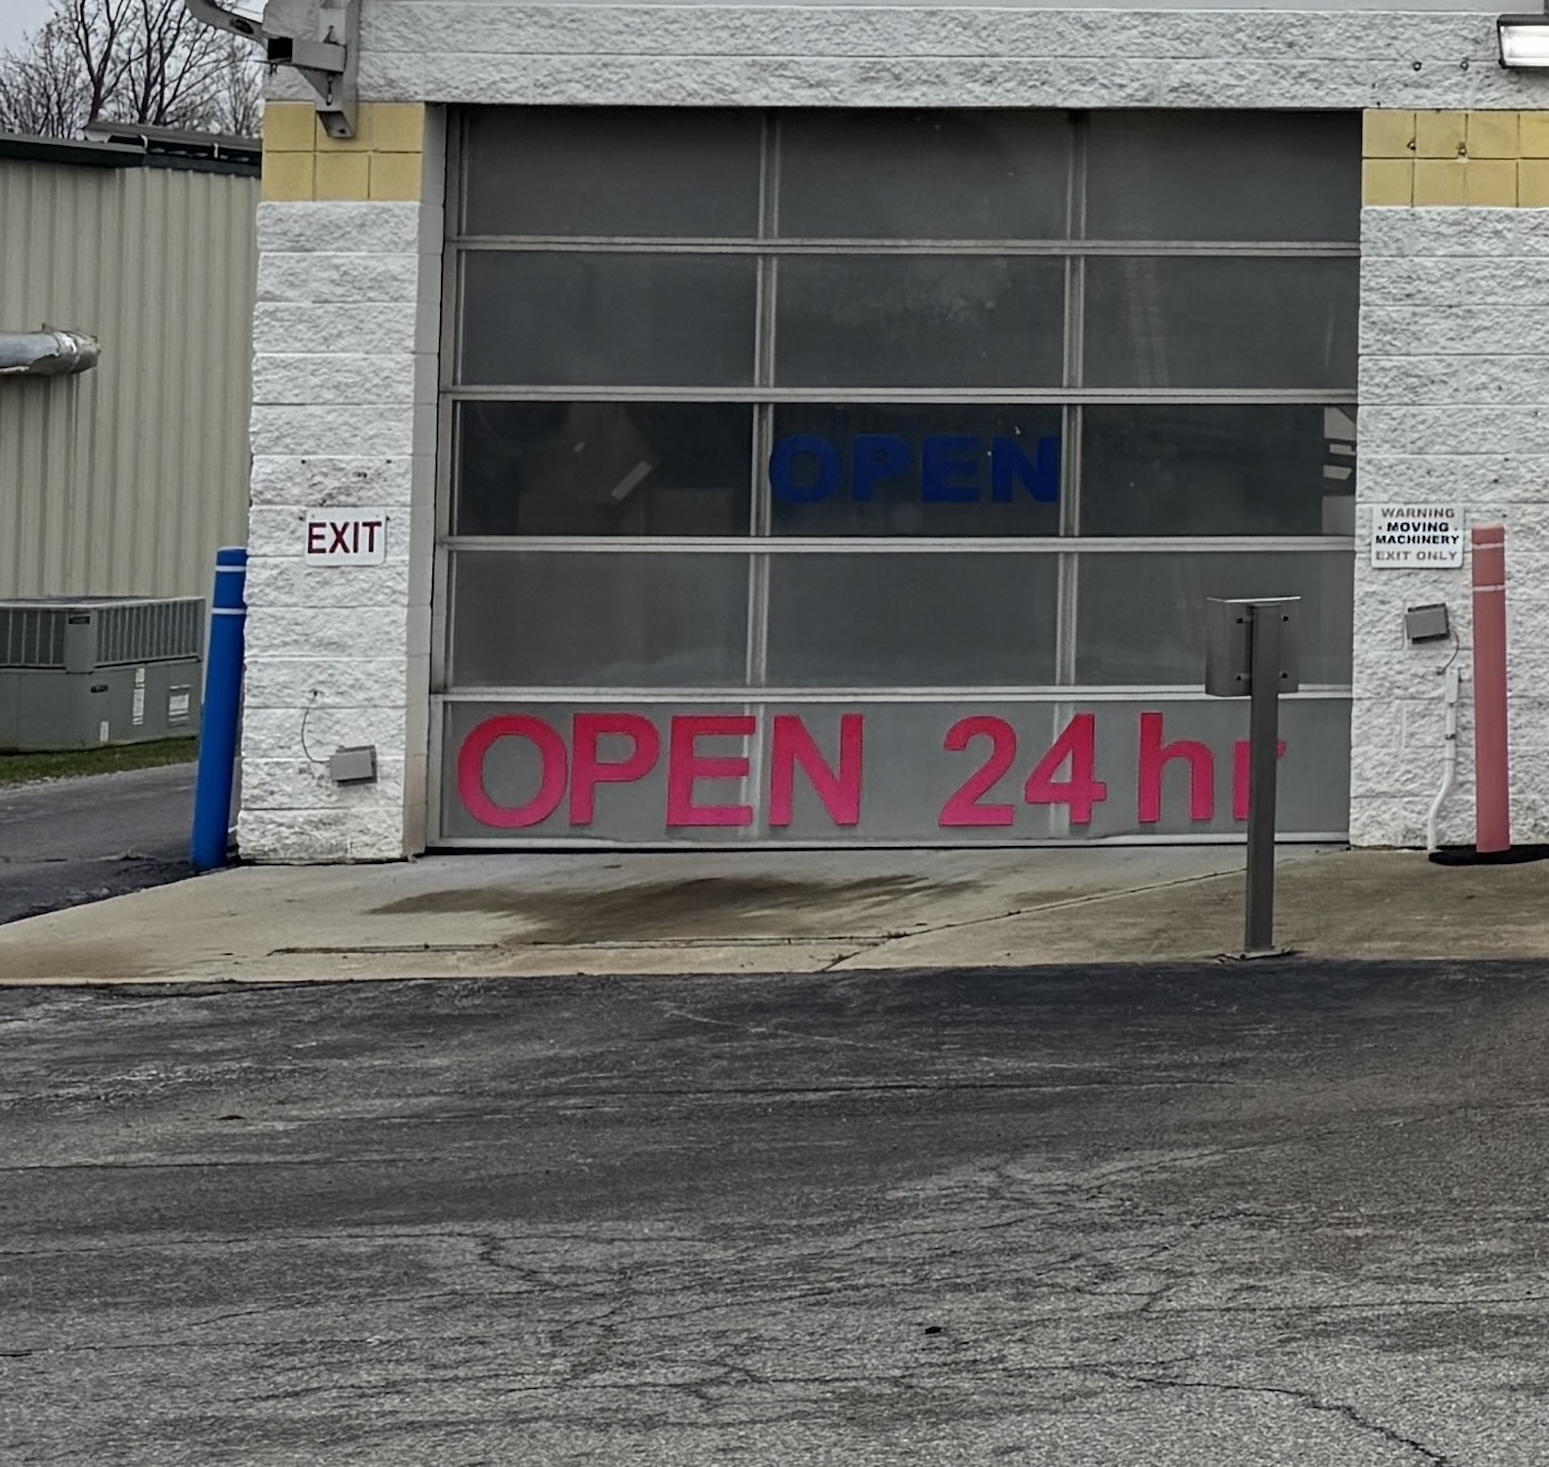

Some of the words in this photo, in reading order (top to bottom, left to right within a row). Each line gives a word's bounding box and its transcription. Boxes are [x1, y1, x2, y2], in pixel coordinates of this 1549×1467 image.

[769, 433, 1060, 505] OPEN
[1381, 508, 1455, 518] WARNING
[1387, 522, 1449, 532] MOVING
[306, 519, 383, 555] EXIT
[1375, 535, 1459, 544] MACHINERY
[1376, 551, 1411, 560] EXIT
[1416, 551, 1457, 560] ONLY
[457, 712, 865, 829] OPEN
[939, 712, 1108, 828] 24
